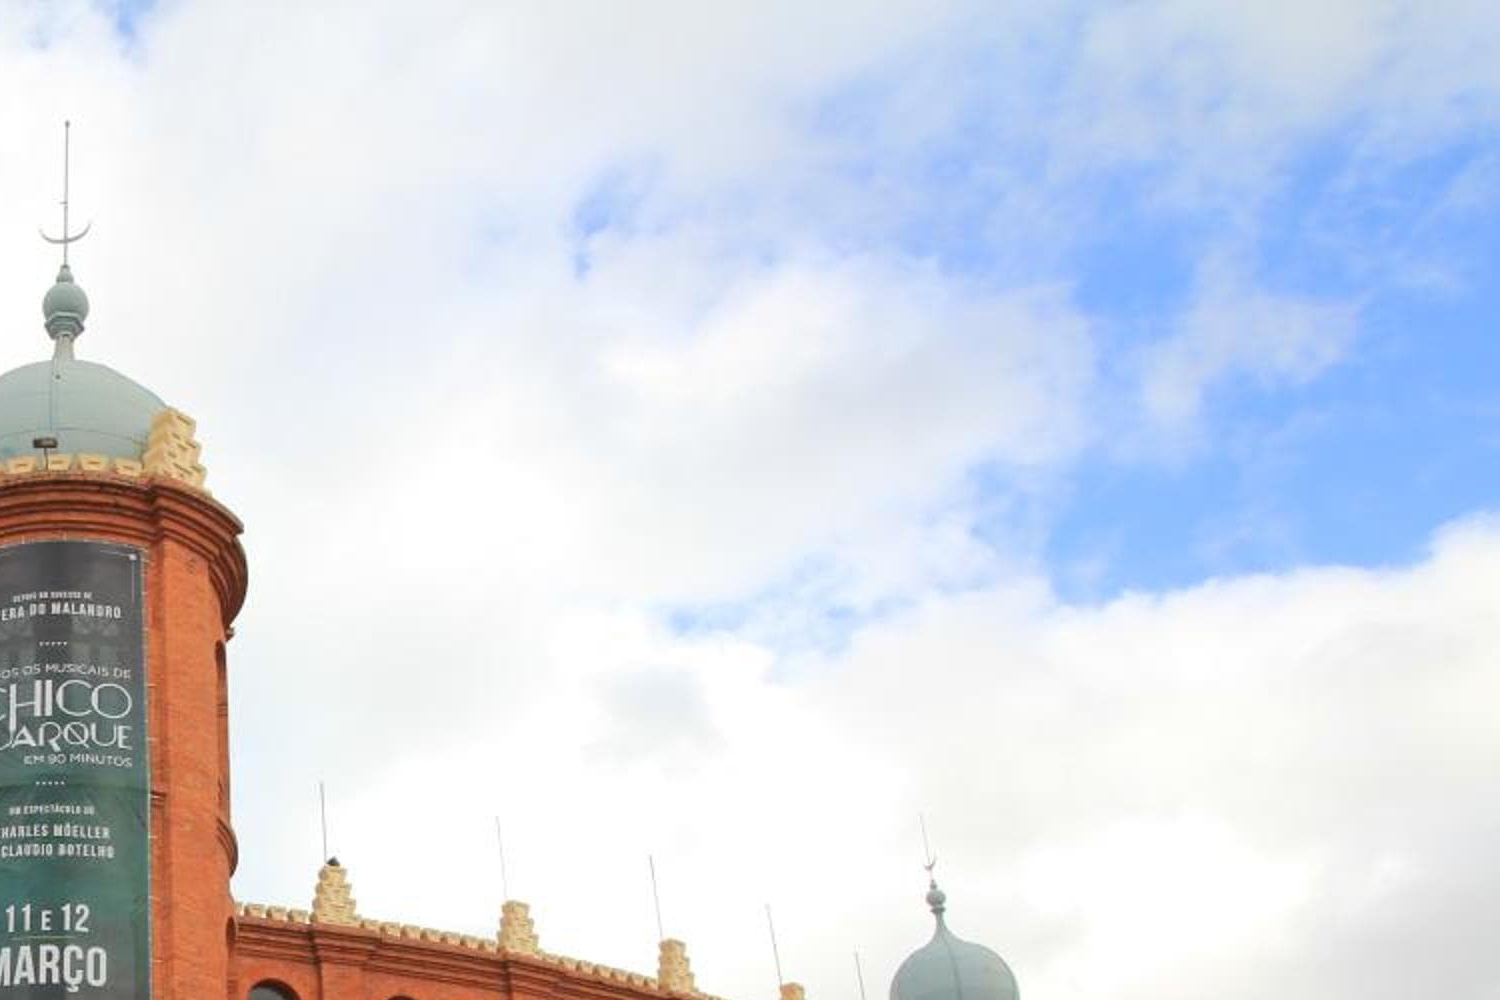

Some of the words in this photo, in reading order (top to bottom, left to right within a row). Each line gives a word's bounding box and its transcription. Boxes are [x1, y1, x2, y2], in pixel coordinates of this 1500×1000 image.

[29, 603, 47, 616] DO
[51, 601, 122, 619] MALANDRO
[23, 664, 41, 676] OS
[45, 663, 109, 678] MUSICAIS
[113, 668, 131, 679] DE
[24, 755, 45, 765] EM
[47, 754, 67, 765] 90
[70, 754, 133, 768] MINUTOS
[57, 844, 115, 859] BOTELHO
[5, 904, 33, 933] 11
[41, 910, 52, 931] E
[61, 904, 90, 933] 12
